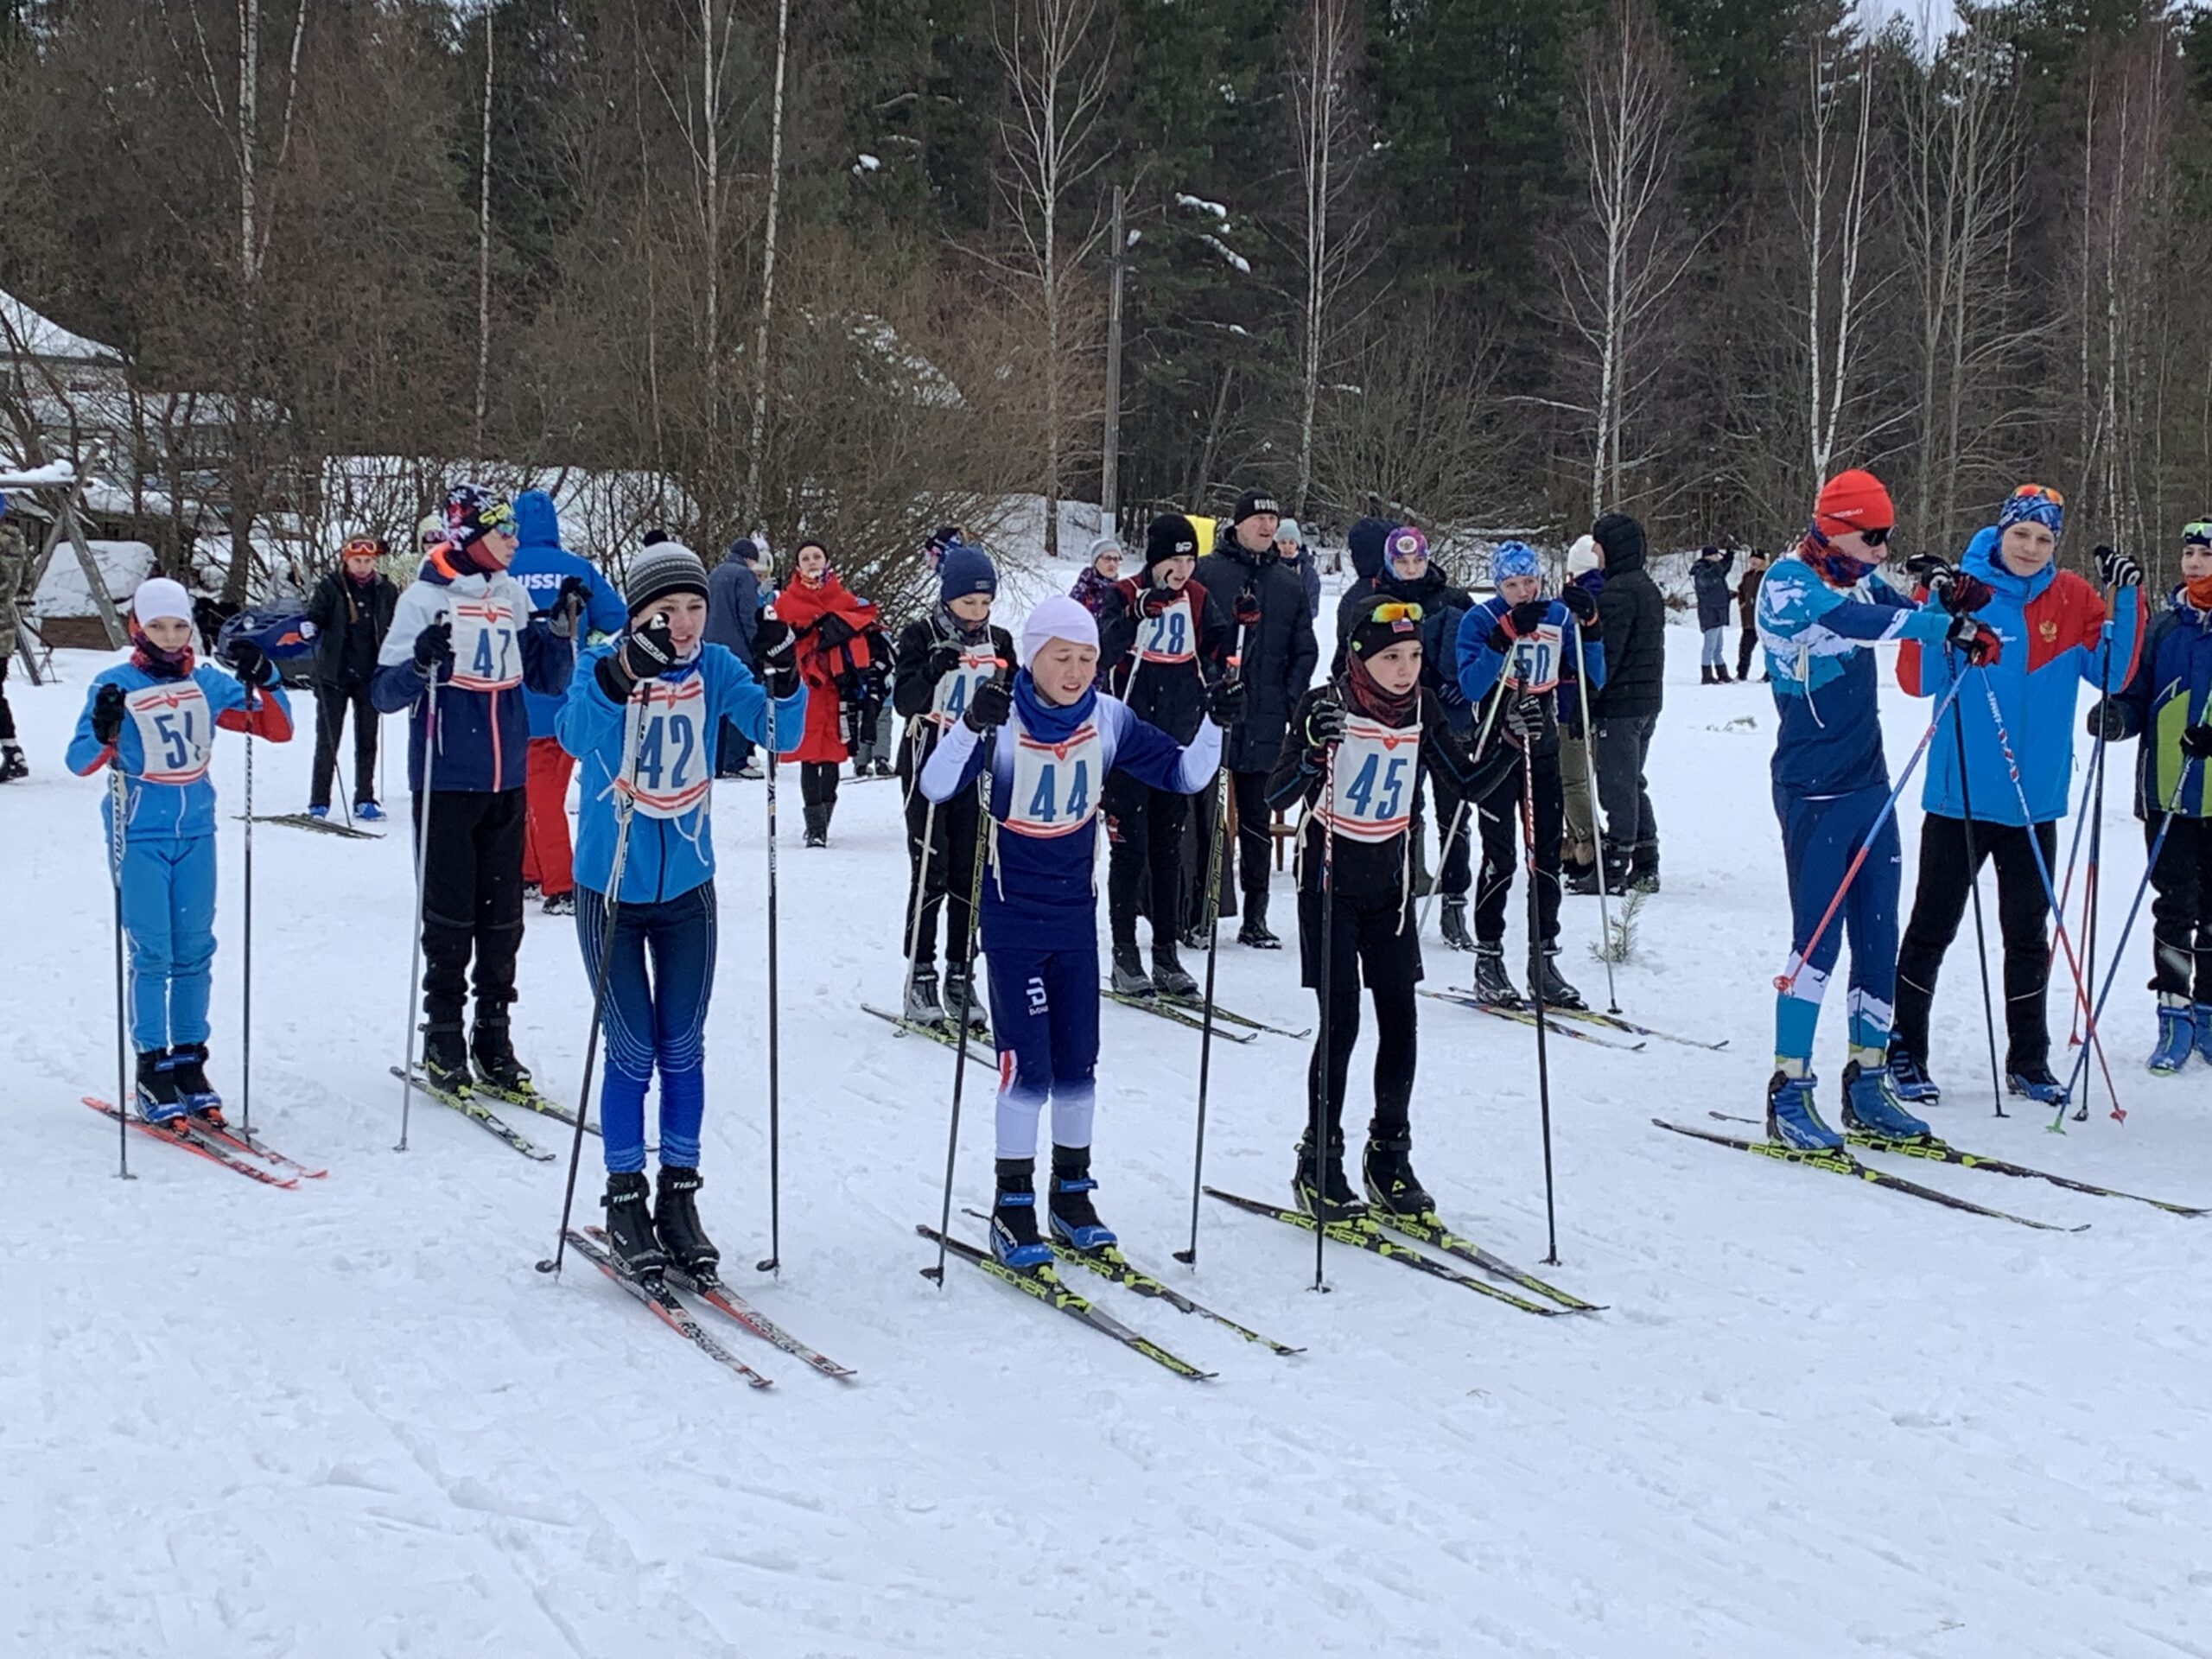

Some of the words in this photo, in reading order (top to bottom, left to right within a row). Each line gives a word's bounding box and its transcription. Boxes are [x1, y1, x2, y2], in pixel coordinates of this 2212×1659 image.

[518, 574, 568, 589] USSI
[1148, 611, 1185, 655] 28
[473, 628, 512, 681] 47
[1514, 644, 1550, 685] 50
[947, 674, 988, 720] 4
[154, 711, 200, 769] 51
[637, 715, 694, 788] 42
[1029, 760, 1088, 823] 44
[1325, 747, 1334, 862] MADSHUS
[1345, 753, 1408, 820] 45
[1747, 1143, 1853, 1175] FISCHER
[1845, 1135, 1948, 1161] ISCHER
[613, 1192, 639, 1204] TISA
[674, 1180, 698, 1189] TISA
[1279, 1211, 1369, 1249] FISCHER
[1368, 1208, 1432, 1241] ISCHER
[980, 1258, 1047, 1300] FISCHER
[1049, 1244, 1114, 1280] SCHER
